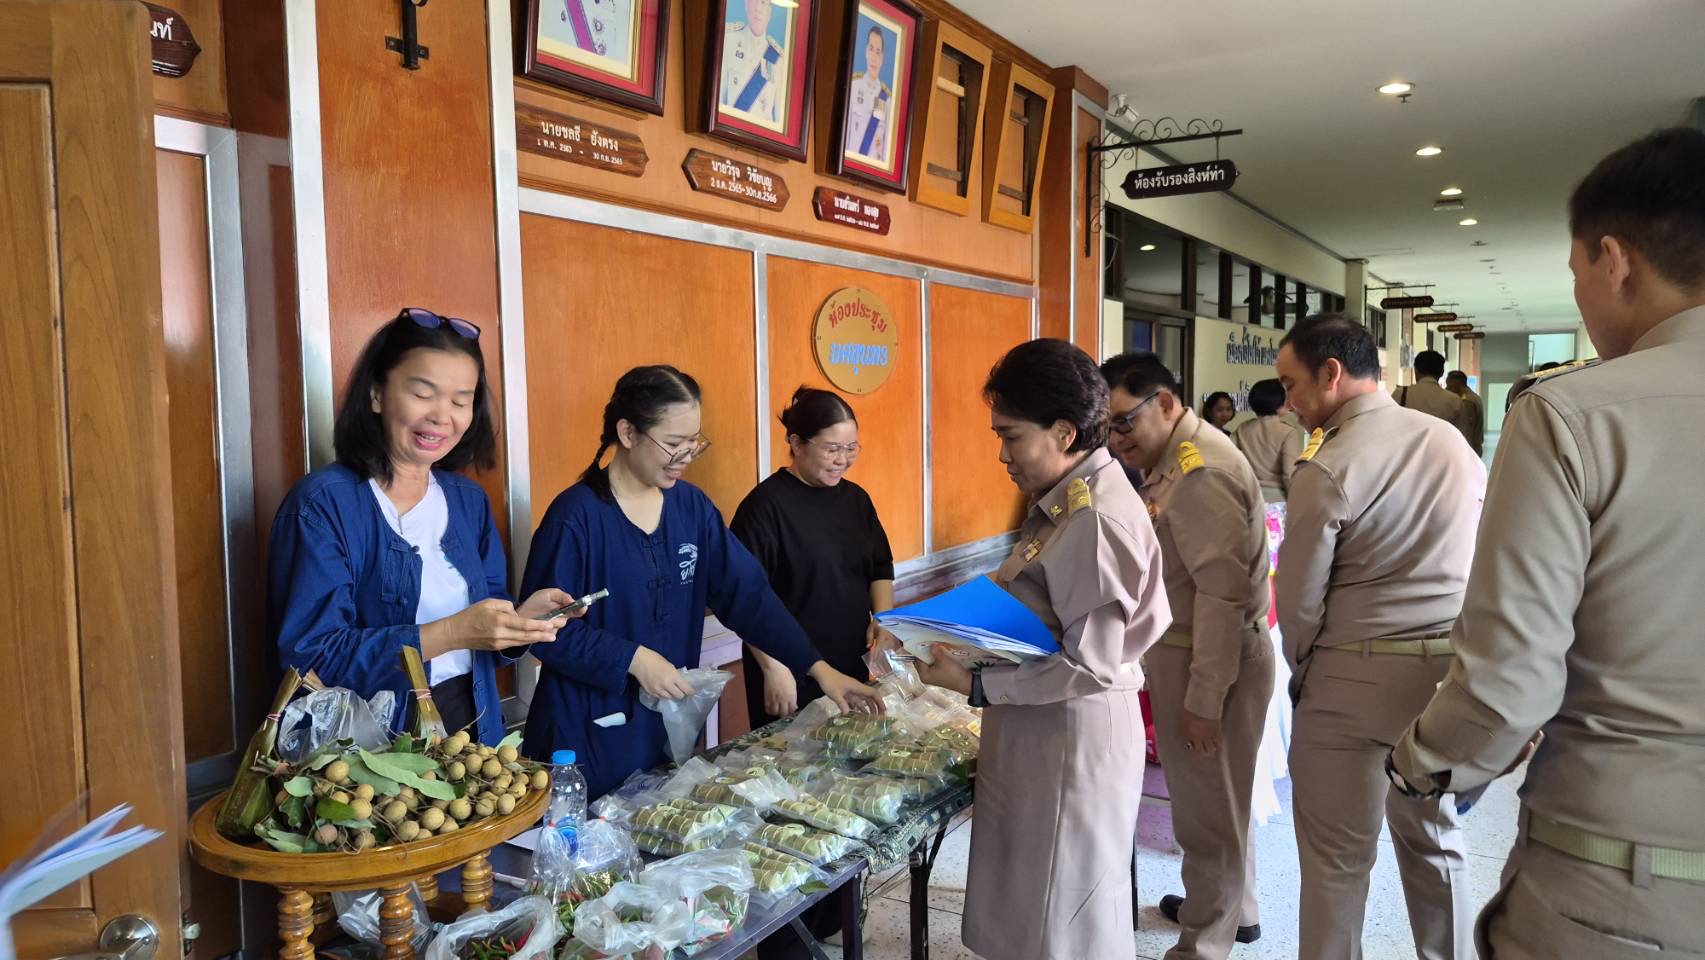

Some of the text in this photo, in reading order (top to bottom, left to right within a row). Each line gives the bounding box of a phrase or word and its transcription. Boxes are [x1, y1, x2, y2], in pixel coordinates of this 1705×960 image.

[541, 121, 619, 152] นายชลธี ยังตรง
[1134, 165, 1225, 190] ห้องรับรองสิงห์ท่า
[828, 297, 887, 334] ห้องประชุม
